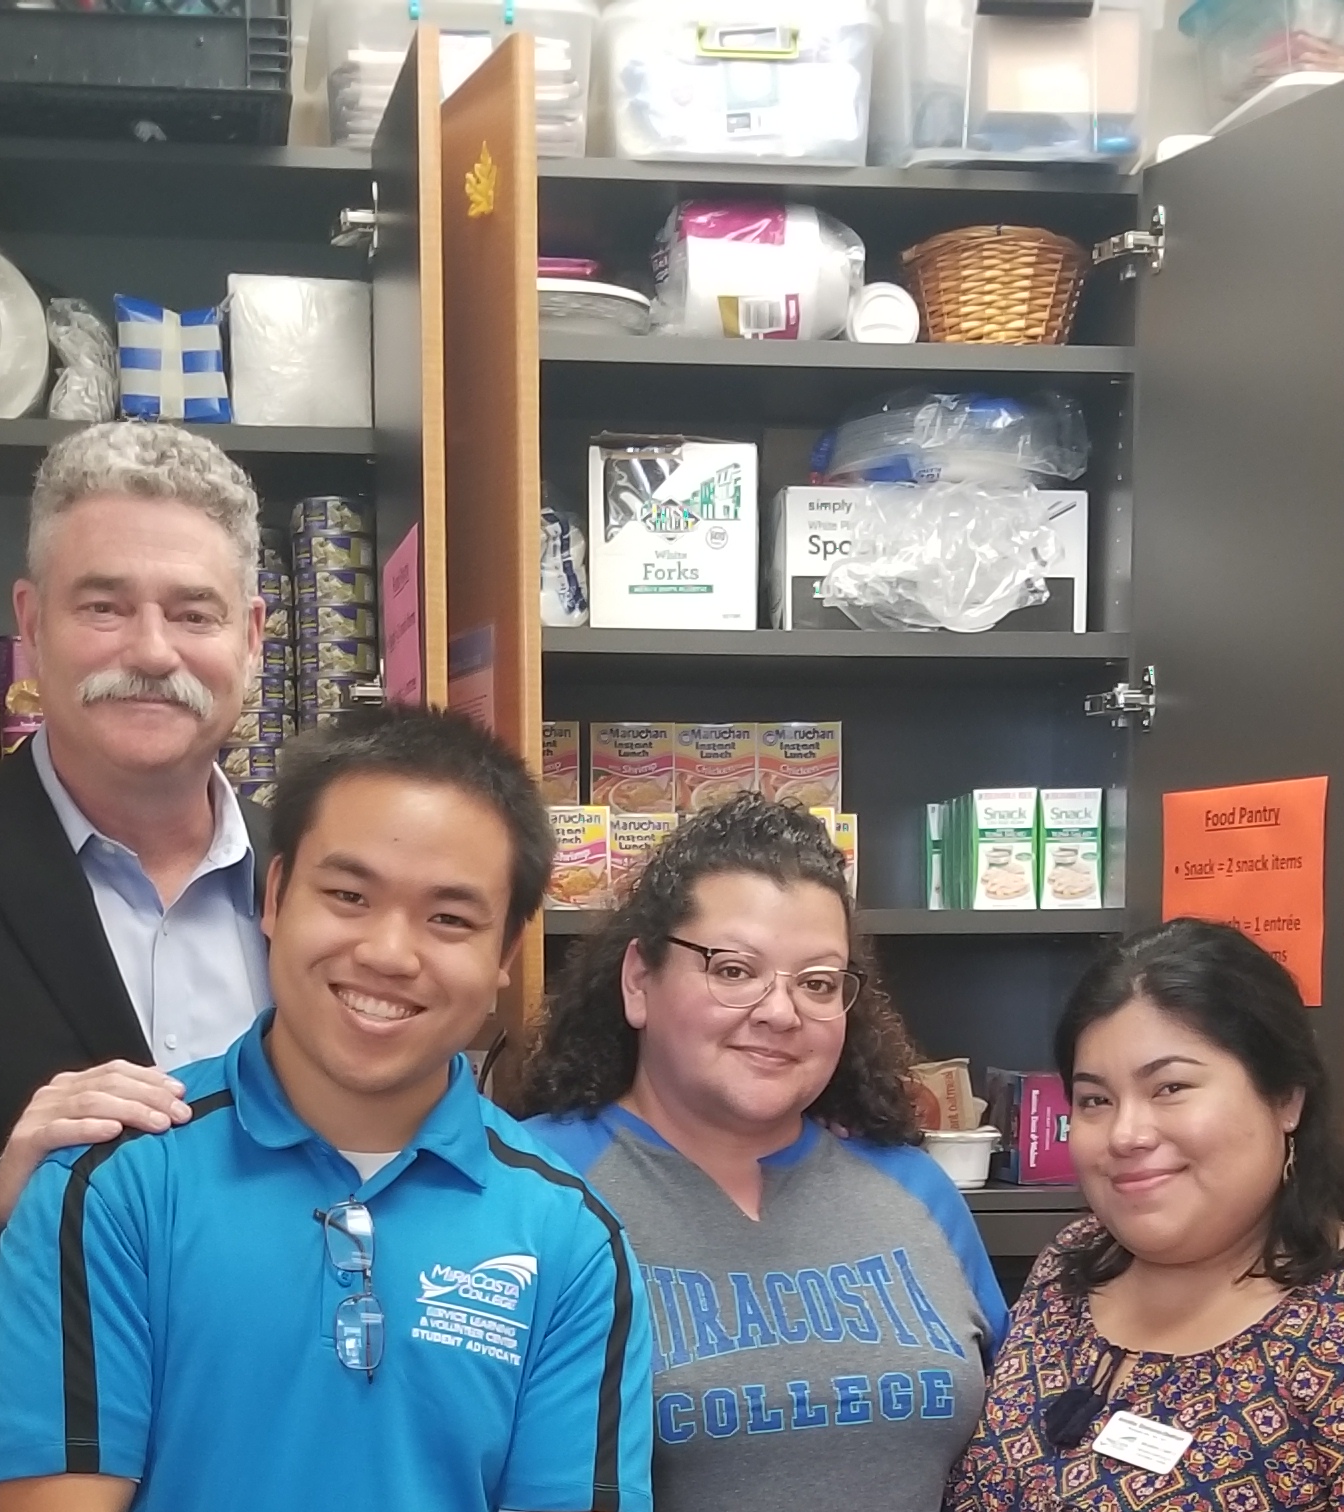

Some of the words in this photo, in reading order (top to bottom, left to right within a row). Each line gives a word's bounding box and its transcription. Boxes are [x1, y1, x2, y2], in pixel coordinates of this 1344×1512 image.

[808, 499, 853, 514] simply
[643, 561, 700, 581] Forks
[610, 727, 668, 740] Maruchan
[691, 728, 750, 741] Maruchan
[775, 728, 835, 741] Maruchan
[614, 741, 654, 750] Instant
[695, 741, 736, 751] Instant
[779, 741, 821, 751] Instant
[618, 749, 650, 758] Lunch
[700, 750, 733, 759] Lunch
[784, 750, 817, 759] Lunch
[622, 763, 658, 775] Shrimp
[983, 806, 1028, 822] Snack
[1049, 806, 1094, 822] Snack
[1205, 806, 1236, 828] Food
[1238, 805, 1281, 827] Pantry
[610, 819, 671, 832] Maruchan
[614, 832, 657, 844] Instant
[1184, 858, 1214, 877] Snack
[1225, 857, 1233, 875] 2
[1235, 854, 1268, 872] snack
[1271, 854, 1303, 871] items
[1263, 913, 1301, 932] entrée
[458, 1285, 517, 1311] COLLEGE
[427, 1306, 467, 1324] SERVICE
[639, 1247, 969, 1375] IRACOSTA
[430, 1318, 485, 1340] VOLUNTEER
[411, 1327, 464, 1347] STUDENT
[466, 1340, 522, 1366] ADVOCATE
[657, 1368, 956, 1444] COLLEGE
